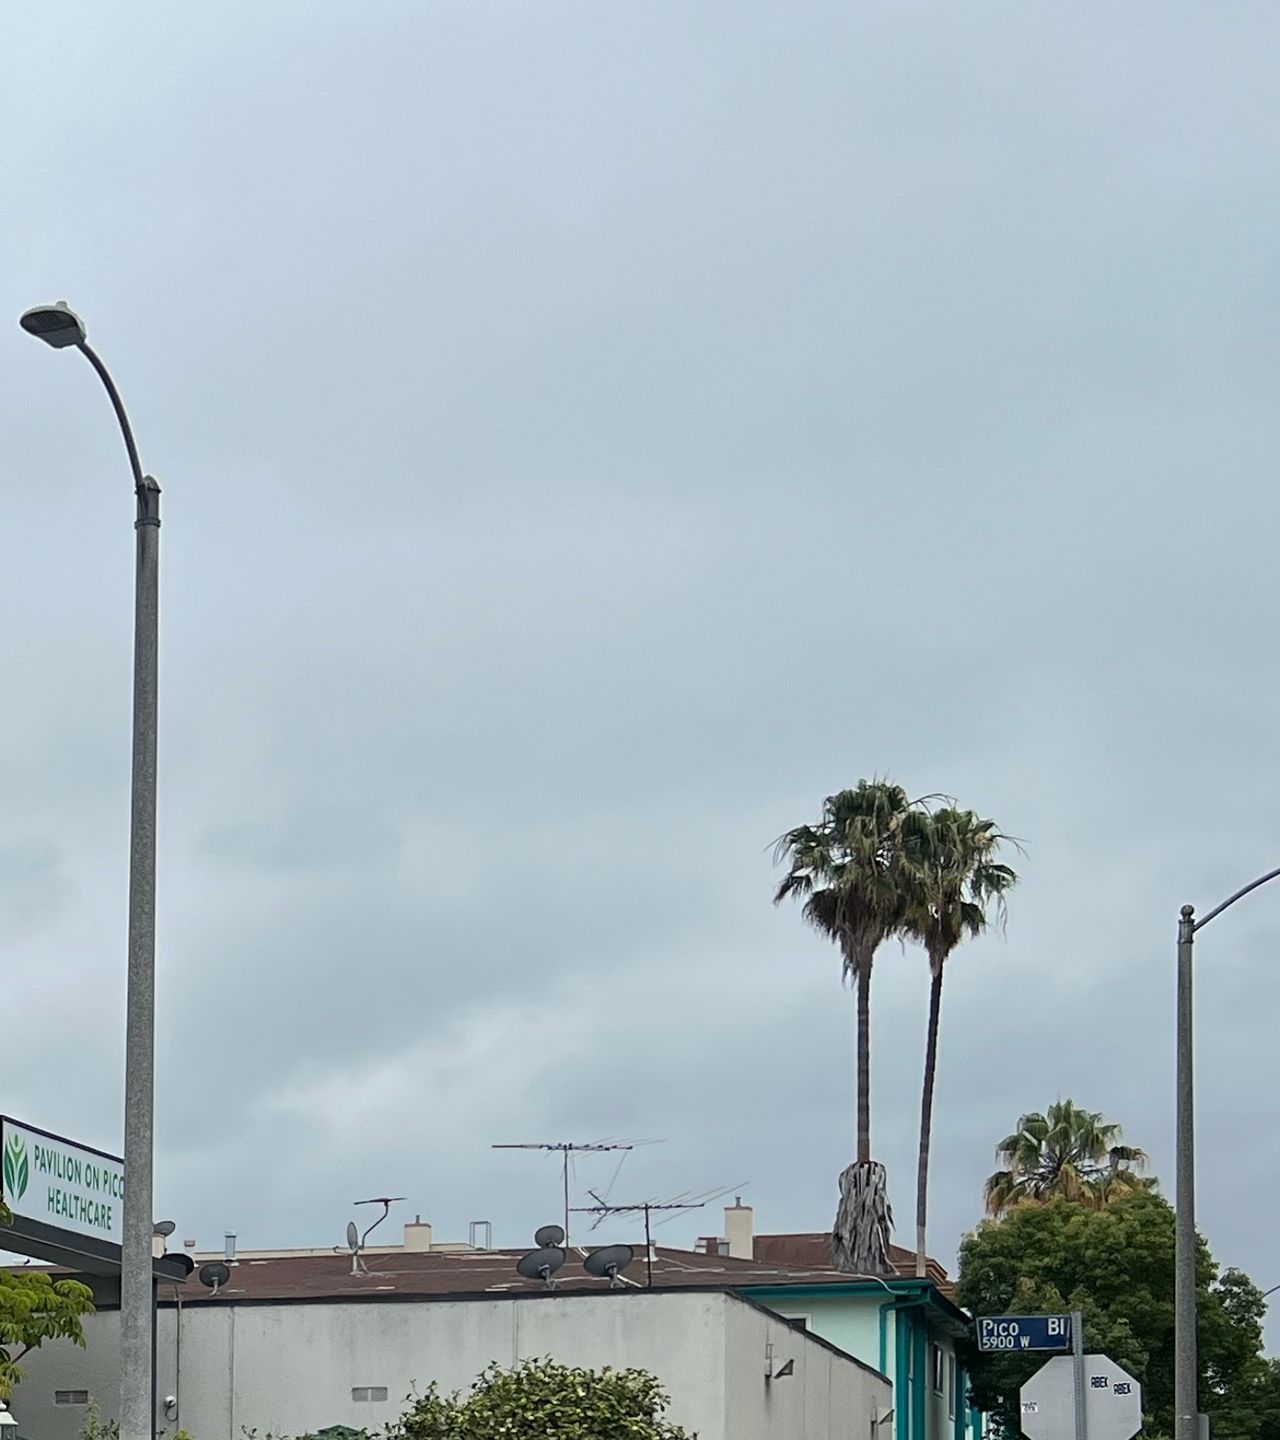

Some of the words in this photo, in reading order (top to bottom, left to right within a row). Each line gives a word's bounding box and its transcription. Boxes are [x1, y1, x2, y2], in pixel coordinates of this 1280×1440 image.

[34, 1144, 82, 1185] PAVILION
[84, 1163, 100, 1191] ON
[47, 1186, 112, 1231] HEALTHCARE
[982, 1335, 1015, 1349] 5900
[1019, 1335, 1030, 1348] W
